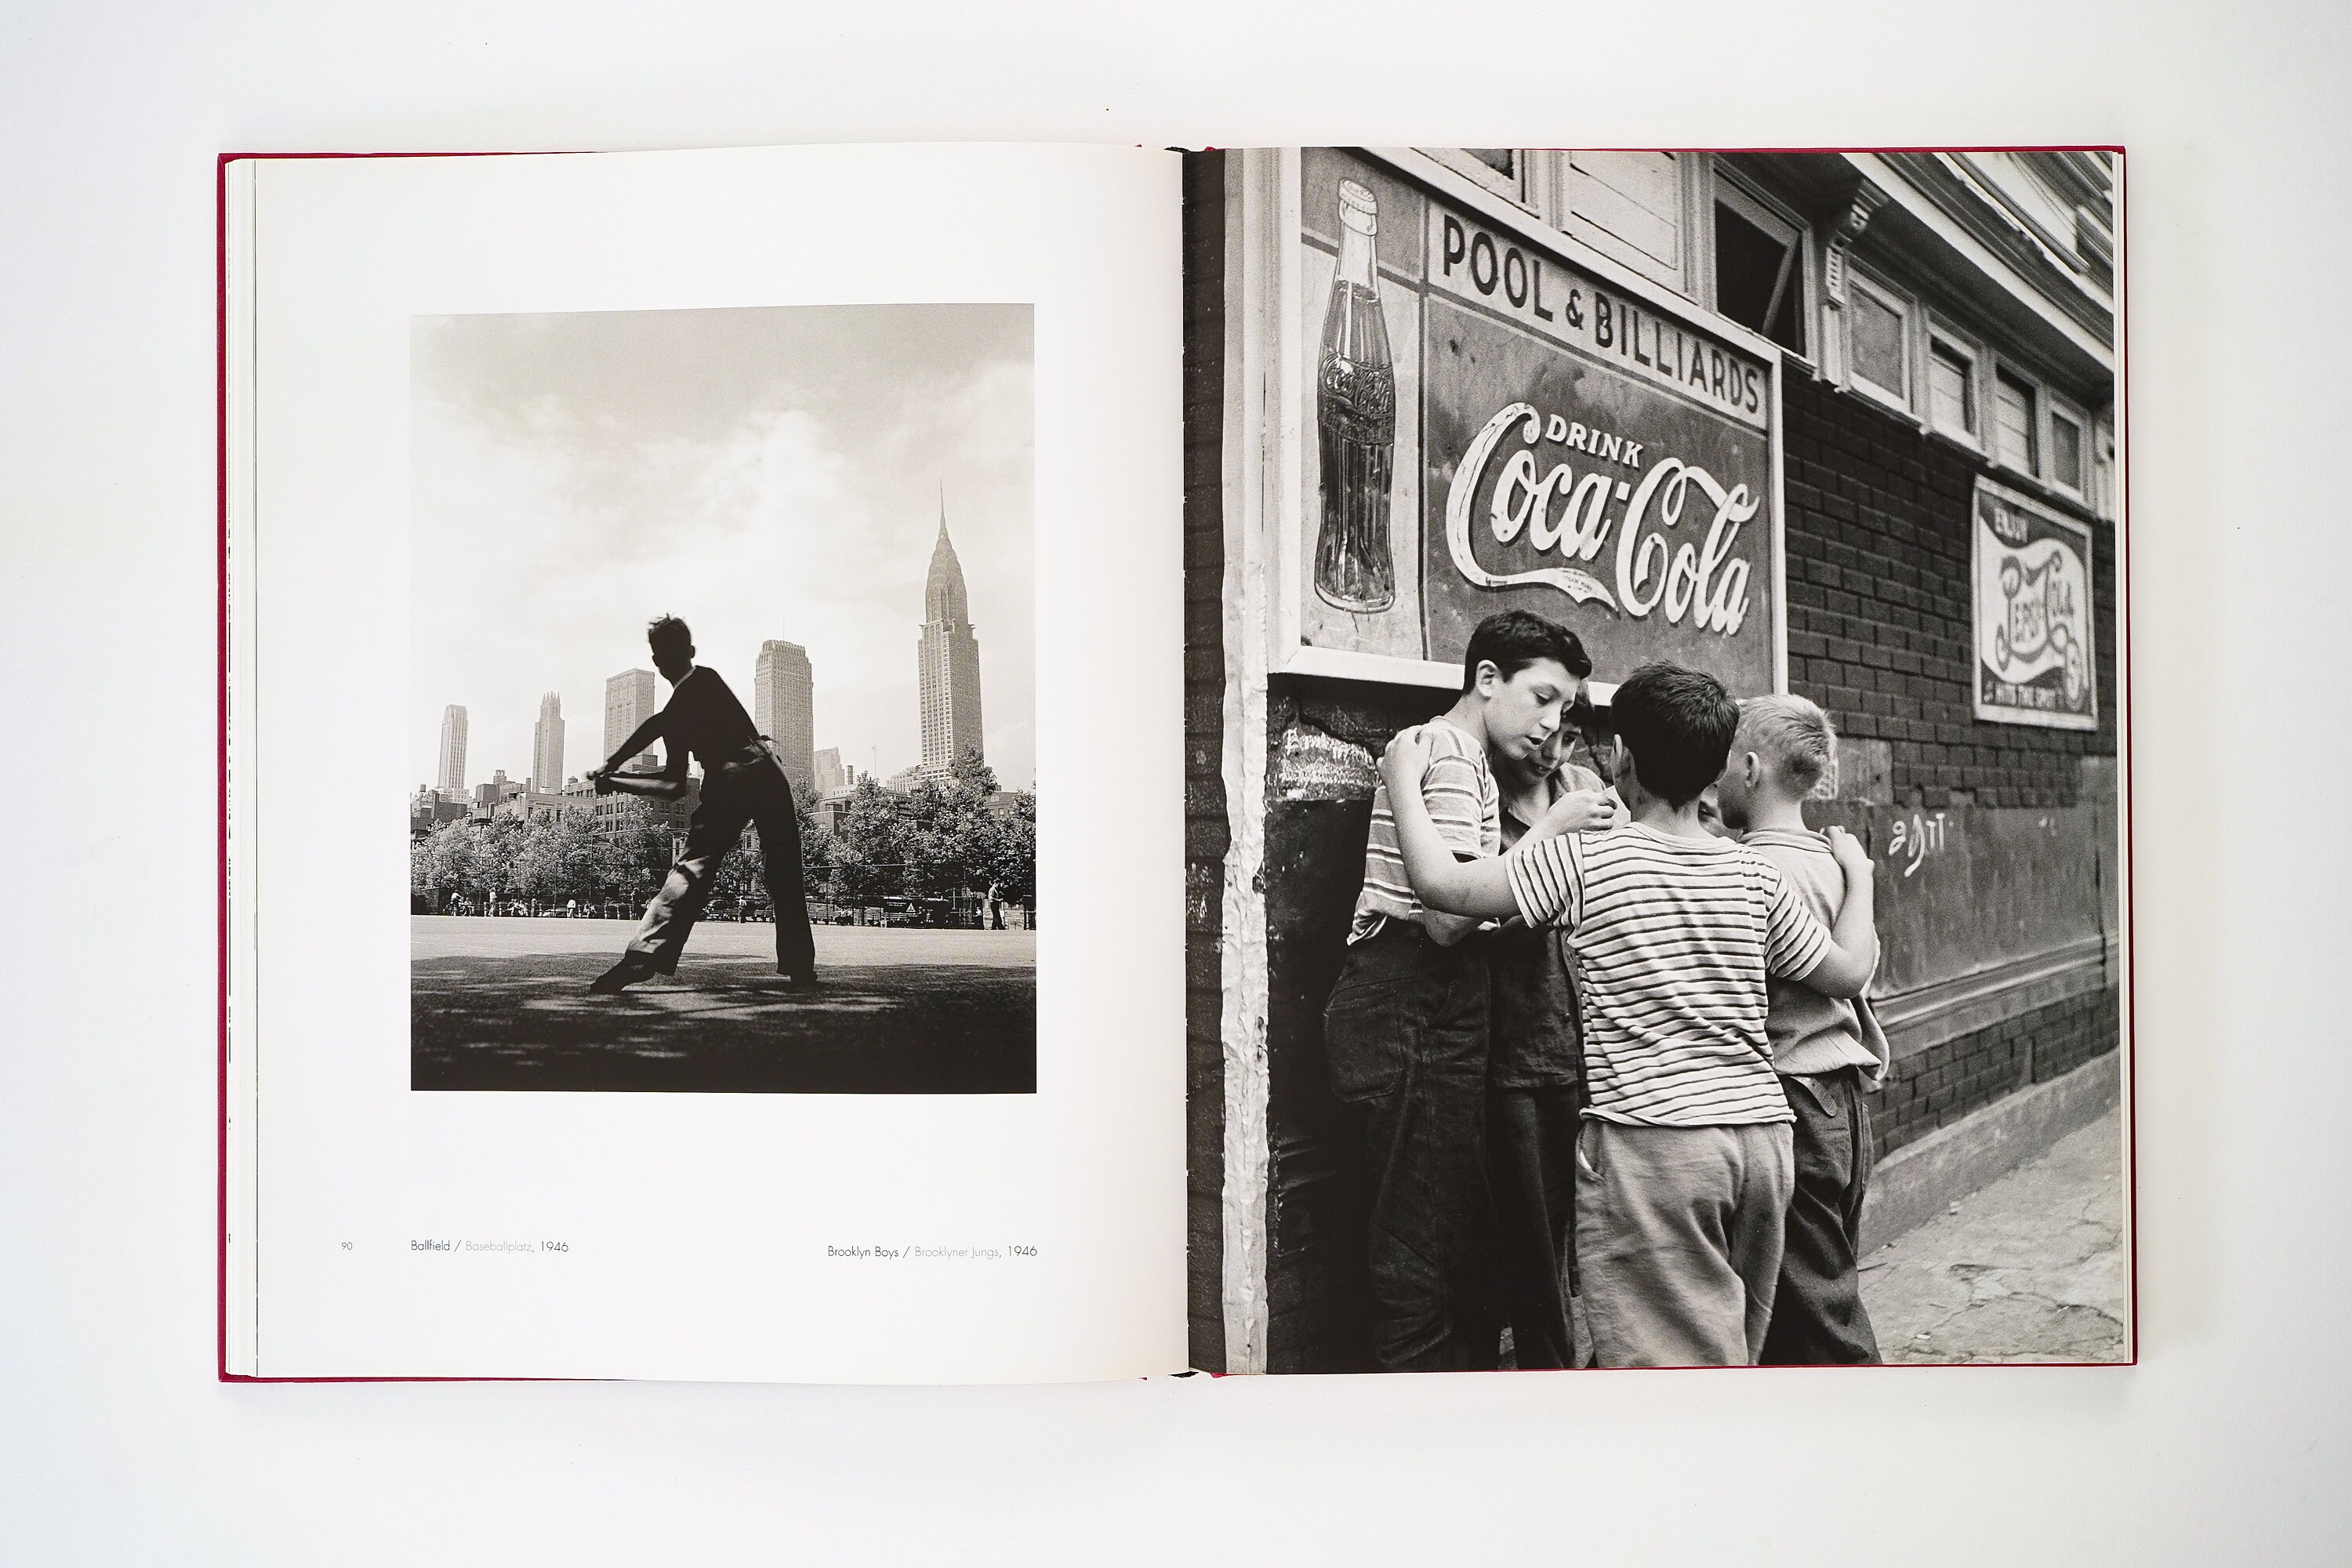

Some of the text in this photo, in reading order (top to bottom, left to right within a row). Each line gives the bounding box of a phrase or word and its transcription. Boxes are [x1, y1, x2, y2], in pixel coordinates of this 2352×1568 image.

[1443, 214, 1760, 414] POOL & BILLIARDS
[1545, 413, 1645, 469] DRINK
[1446, 402, 1760, 635] Coca-Cola
[340, 1242, 353, 1251] 90
[411, 1240, 450, 1251] Ballfield
[466, 1240, 535, 1254] Baseballplatz,
[541, 1241, 569, 1253] 1946
[828, 1245, 871, 1259] Brooklyn
[874, 1246, 899, 1260] Boys
[915, 1246, 968, 1259] Brooklyner
[971, 1247, 1002, 1260] Jungs,
[1009, 1245, 1038, 1257] 1946
